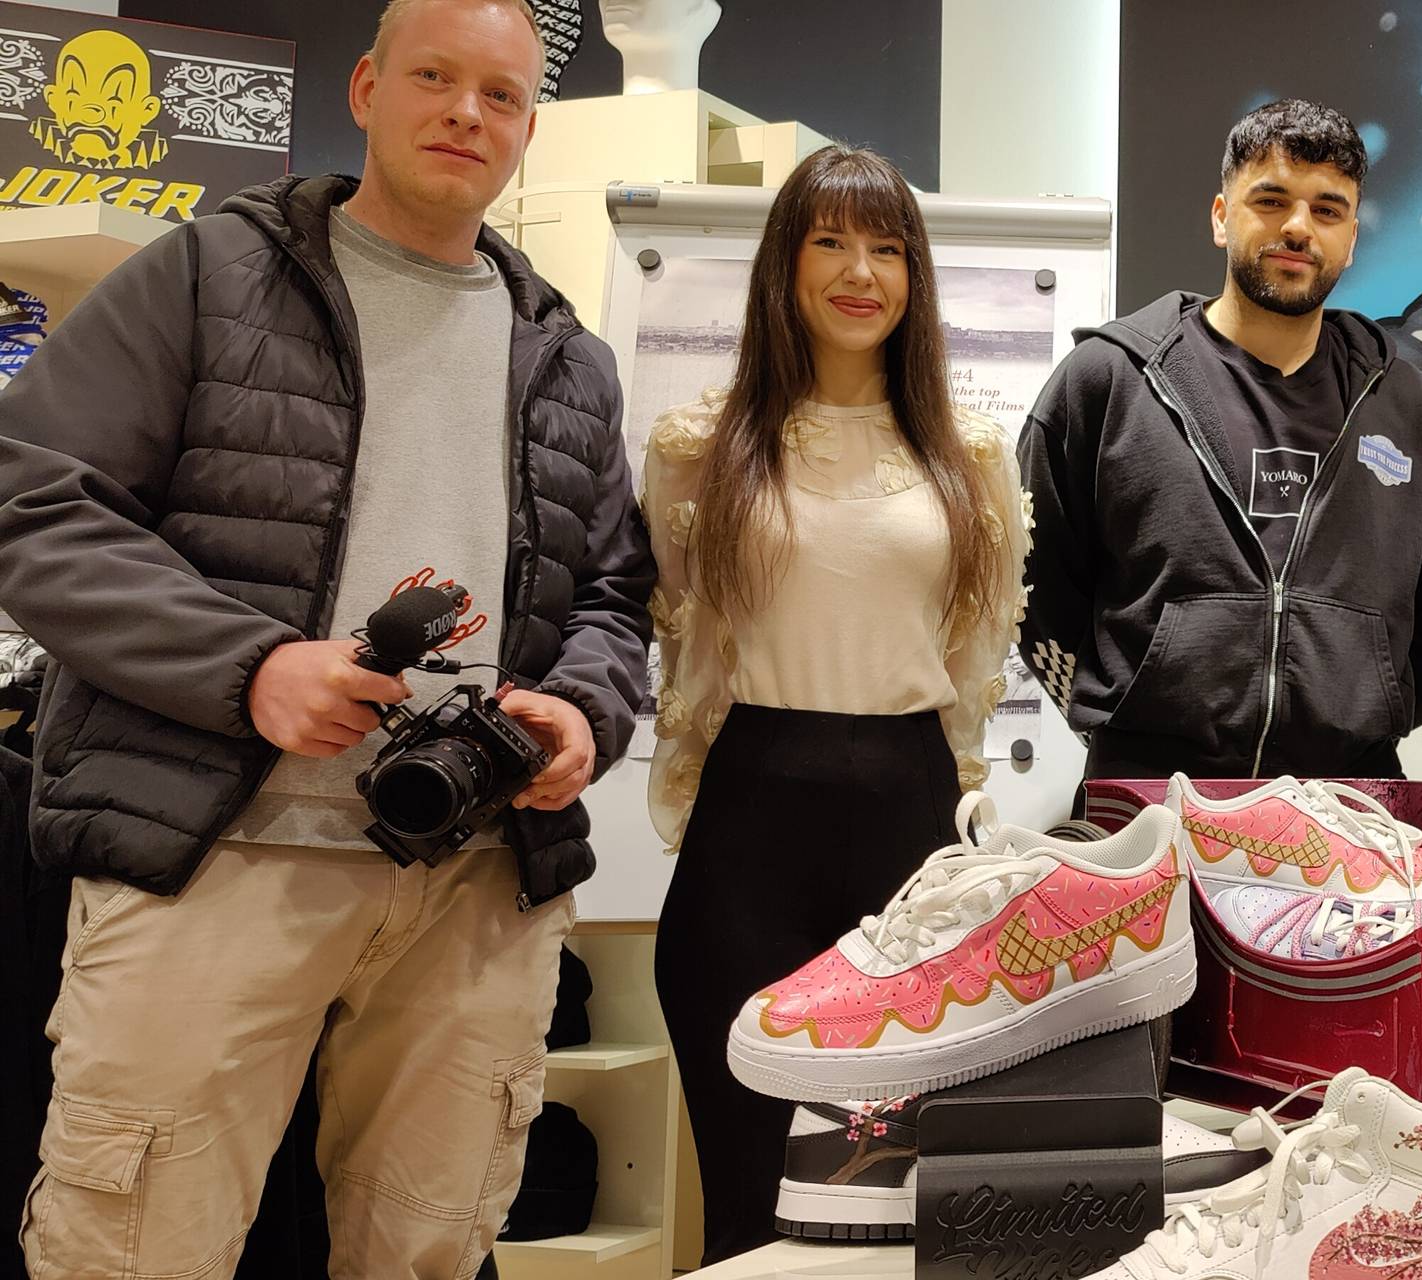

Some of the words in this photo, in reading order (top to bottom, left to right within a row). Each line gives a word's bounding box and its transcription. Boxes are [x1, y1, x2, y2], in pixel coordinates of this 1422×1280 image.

[0, 166, 206, 221] JOKER
[952, 368, 974, 382] #4
[954, 386, 975, 397] the
[979, 388, 1000, 399] top
[986, 400, 1025, 411] Films
[1260, 470, 1308, 485] YOMARO
[934, 1182, 1147, 1263] Limited
